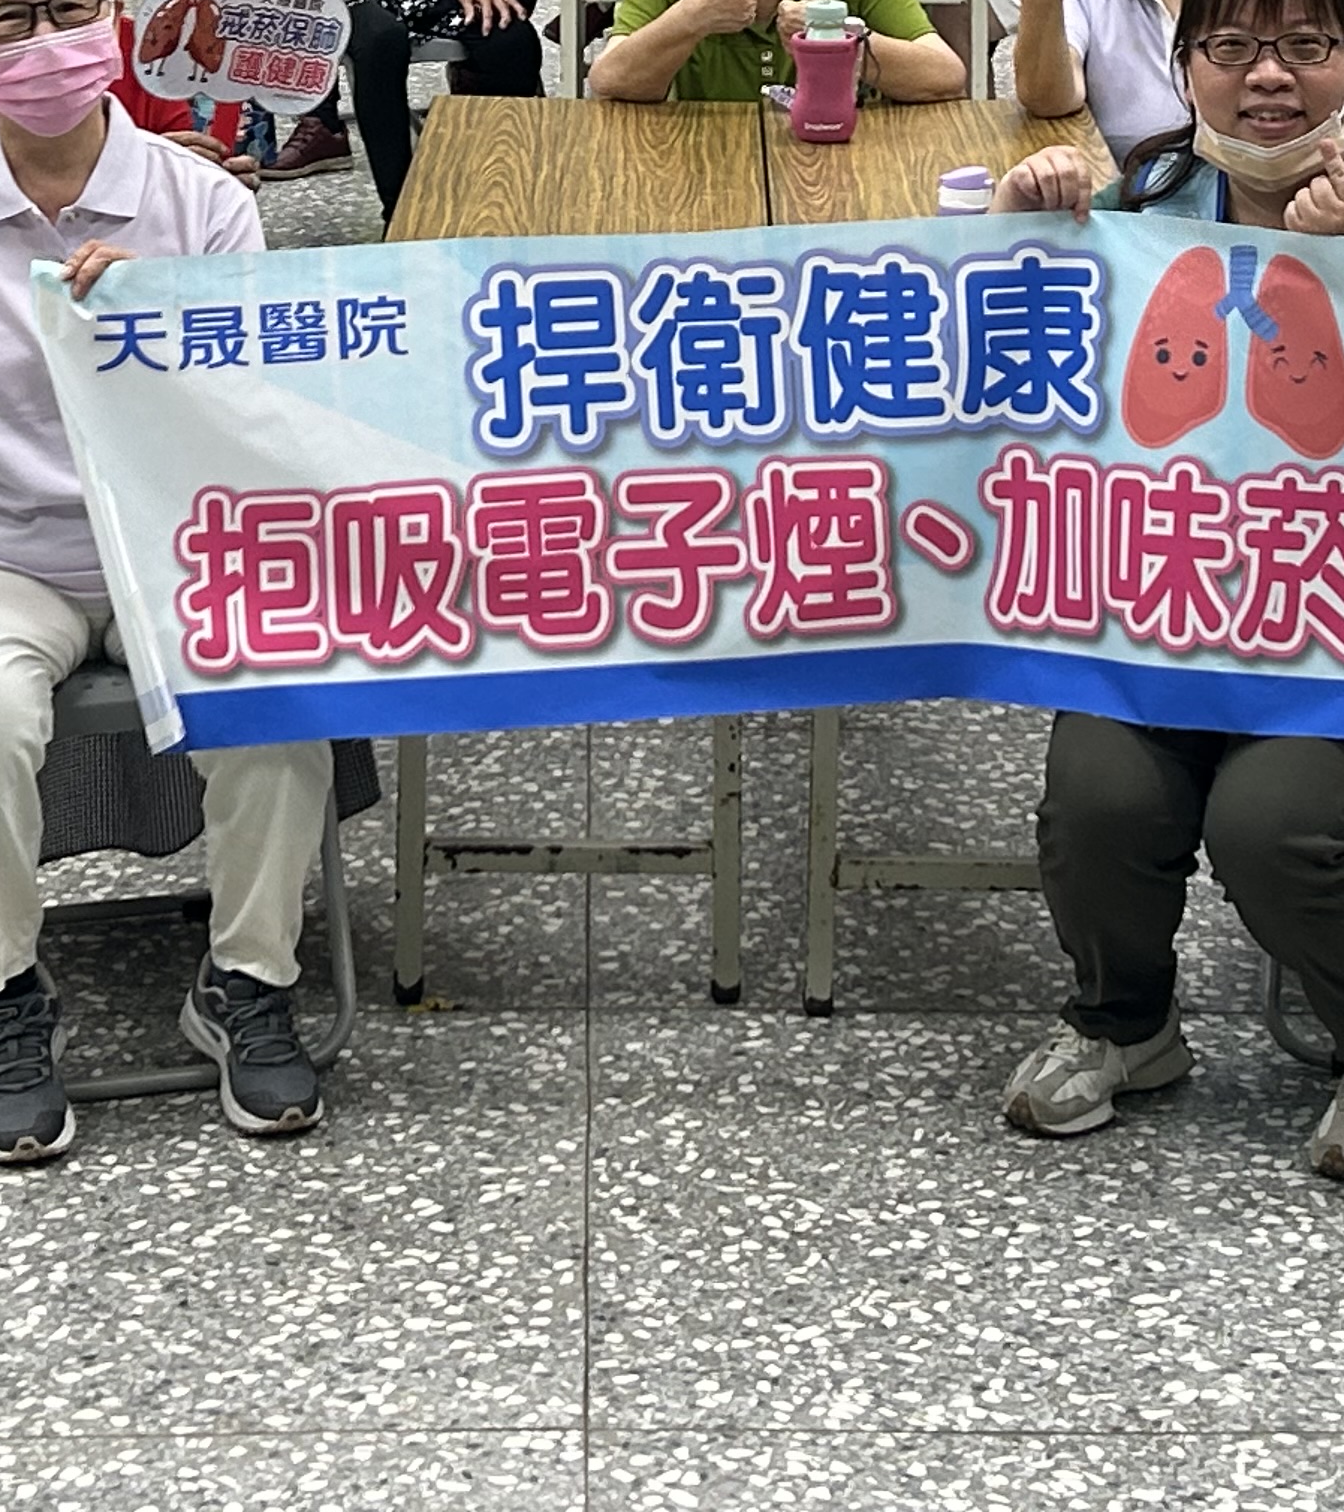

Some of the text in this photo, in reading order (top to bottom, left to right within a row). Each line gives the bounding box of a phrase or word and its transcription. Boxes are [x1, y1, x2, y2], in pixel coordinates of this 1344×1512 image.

[216, 2, 343, 56] 戒菸保肺
[228, 44, 333, 95] 護健康
[93, 294, 410, 374] 天晟醫院
[468, 245, 1108, 450] 捍衛健康
